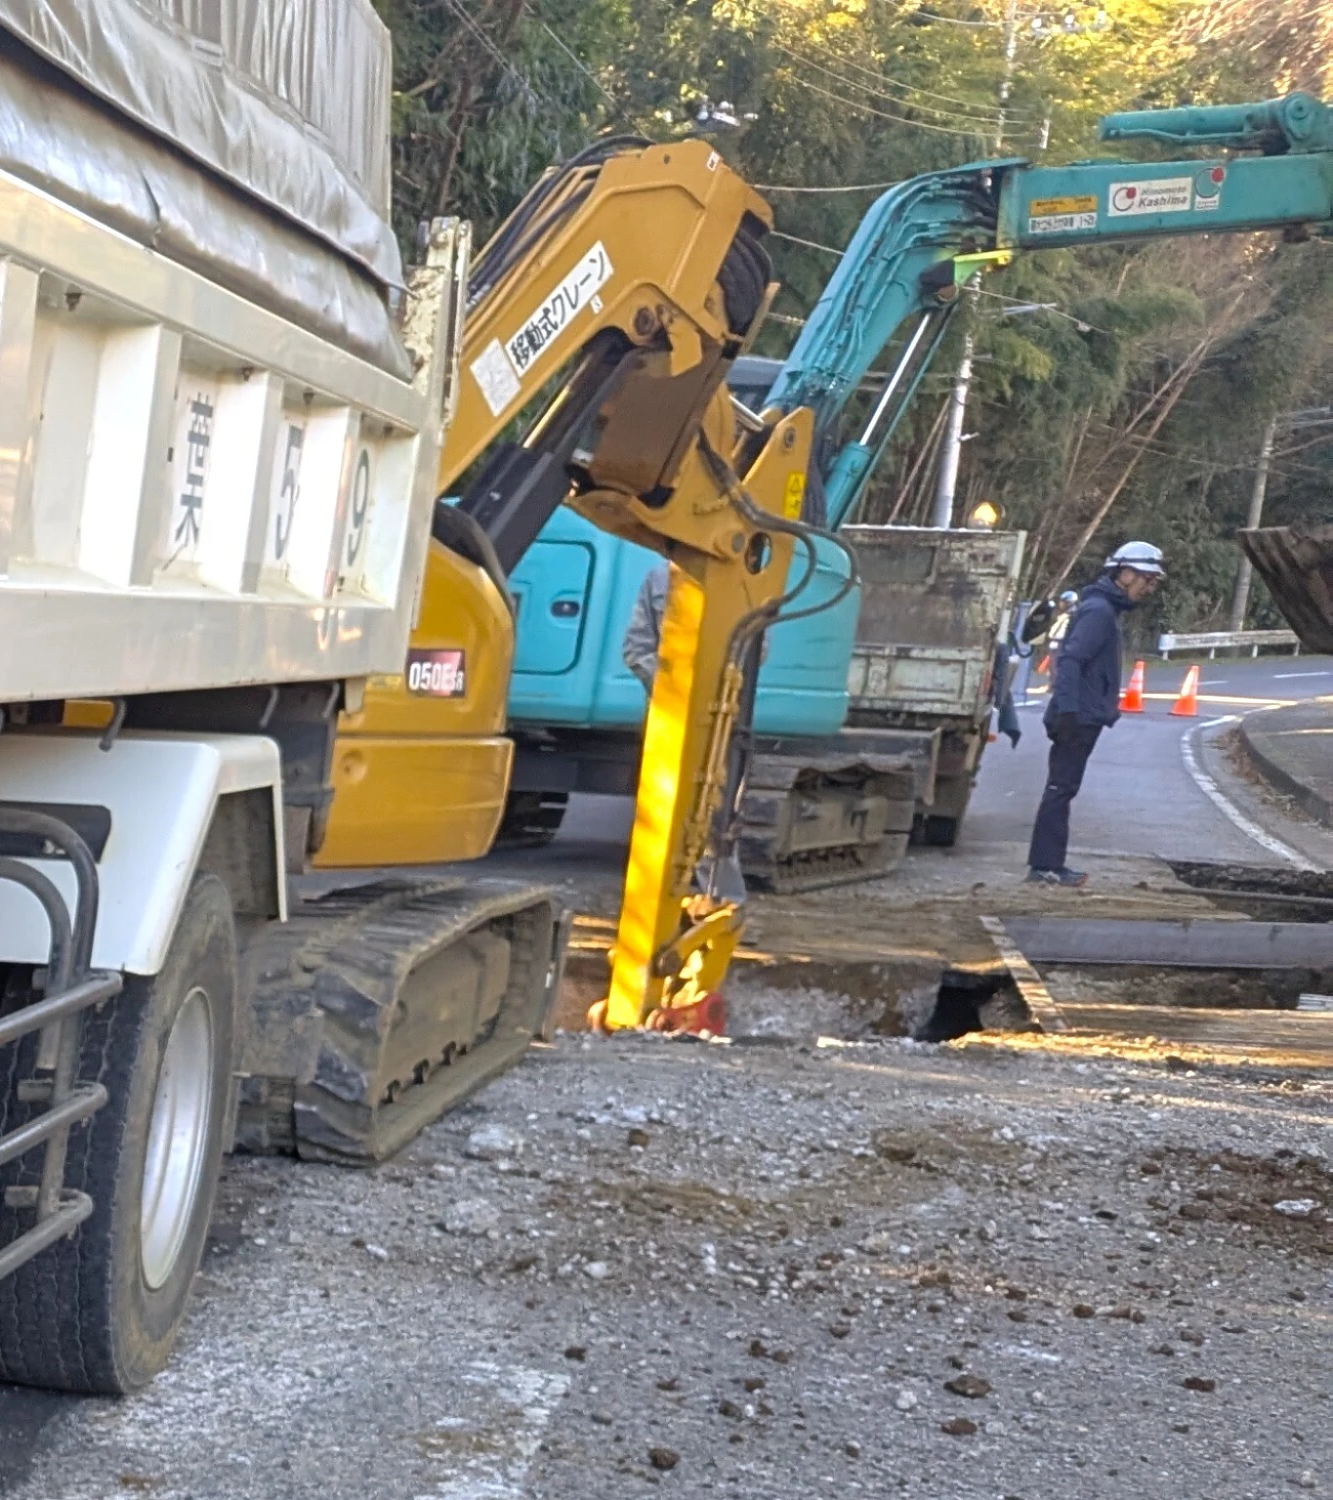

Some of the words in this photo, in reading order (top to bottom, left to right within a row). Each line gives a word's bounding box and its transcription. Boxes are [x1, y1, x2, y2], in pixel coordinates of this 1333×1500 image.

[1138, 195, 1188, 208] Kashima
[511, 250, 604, 369] 移動式クレーン
